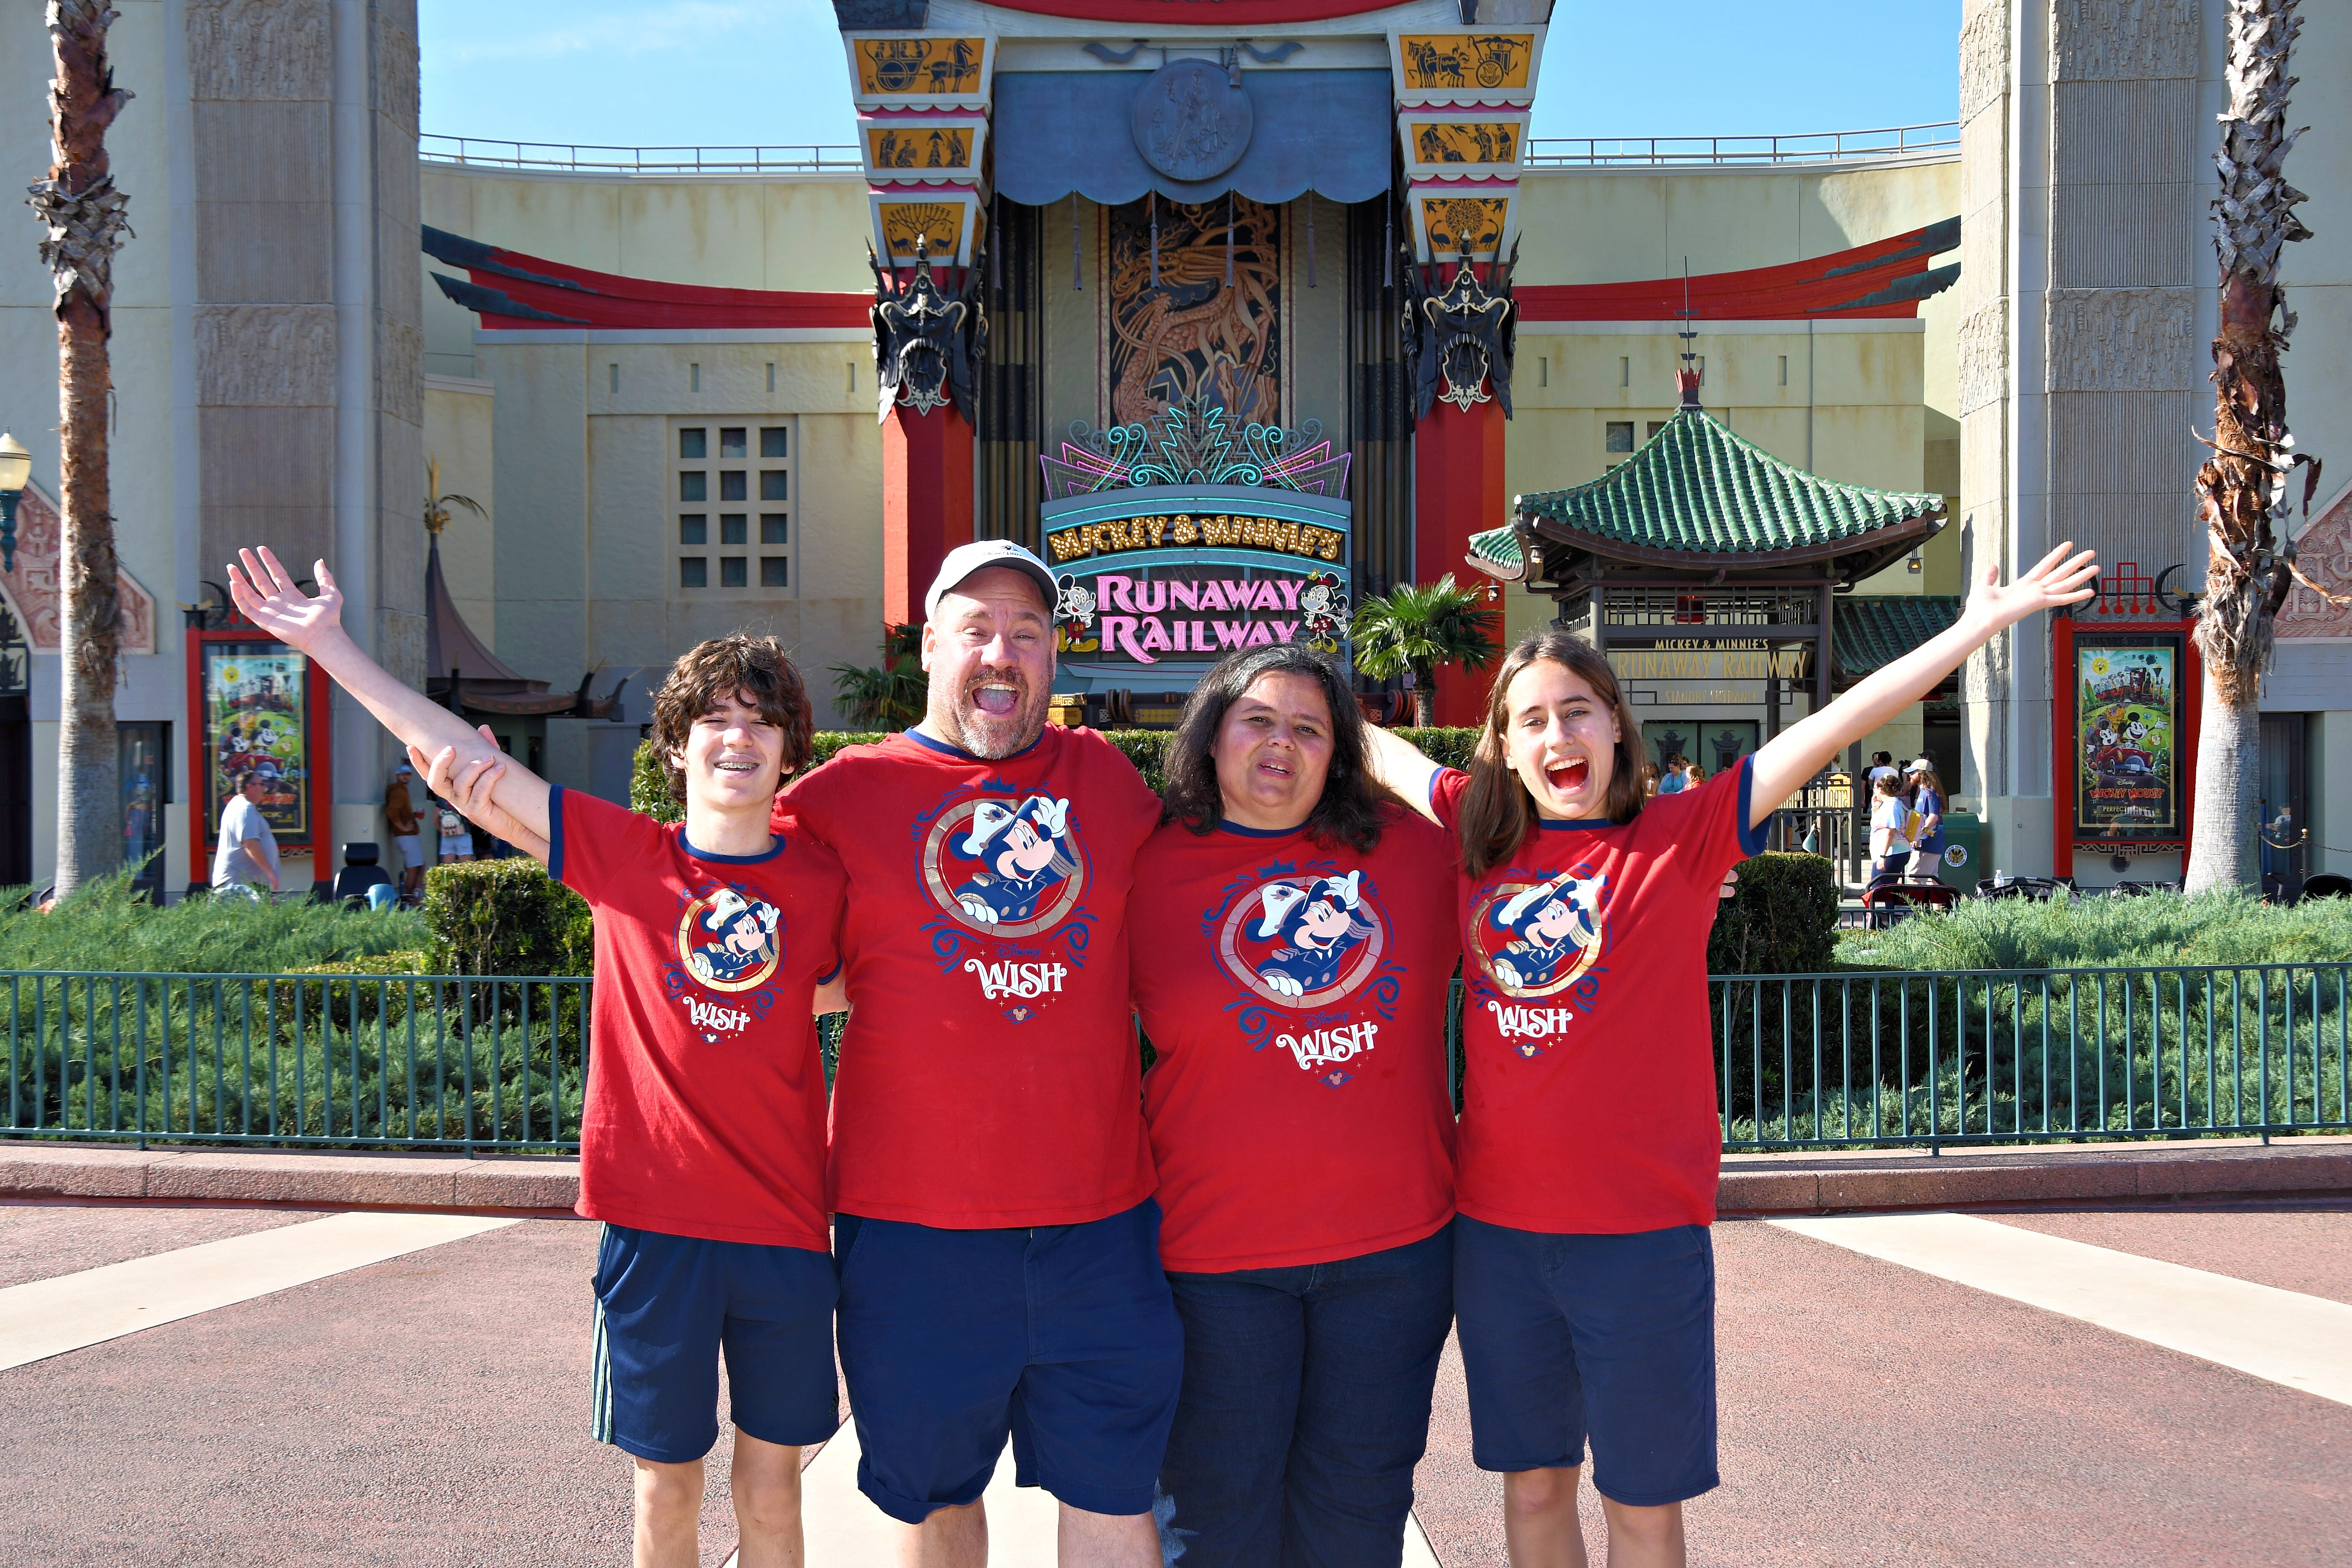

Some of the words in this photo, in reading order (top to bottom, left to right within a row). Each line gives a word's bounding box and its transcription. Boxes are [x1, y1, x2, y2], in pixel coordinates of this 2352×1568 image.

[1048, 516, 1168, 561] MICKEY
[1173, 514, 1200, 544] &
[1200, 514, 1342, 560] MINNIE'S
[1096, 575, 1307, 614] RUNAWAY
[1100, 615, 1300, 664] RAILWAY
[1655, 639, 1699, 650] MICKEY
[1702, 639, 1710, 650] &
[1715, 638, 1769, 650] MINNIE'S
[1617, 651, 1712, 679] RUNAWAY
[1722, 651, 1807, 679] RAILWAY
[1665, 691, 1706, 704] STANDBY
[1710, 690, 1757, 703] ENTRANCE
[2090, 787, 2127, 799] MICKEY
[2127, 787, 2165, 799] MOUSE
[2115, 778, 2136, 787] Disney
[991, 942, 1042, 961] Disney
[964, 958, 1067, 1000] WISH
[682, 996, 751, 1032] WISH
[1299, 1011, 1350, 1029] Disney
[1487, 1000, 1573, 1038] WISH
[1275, 1021, 1378, 1070] WISH
